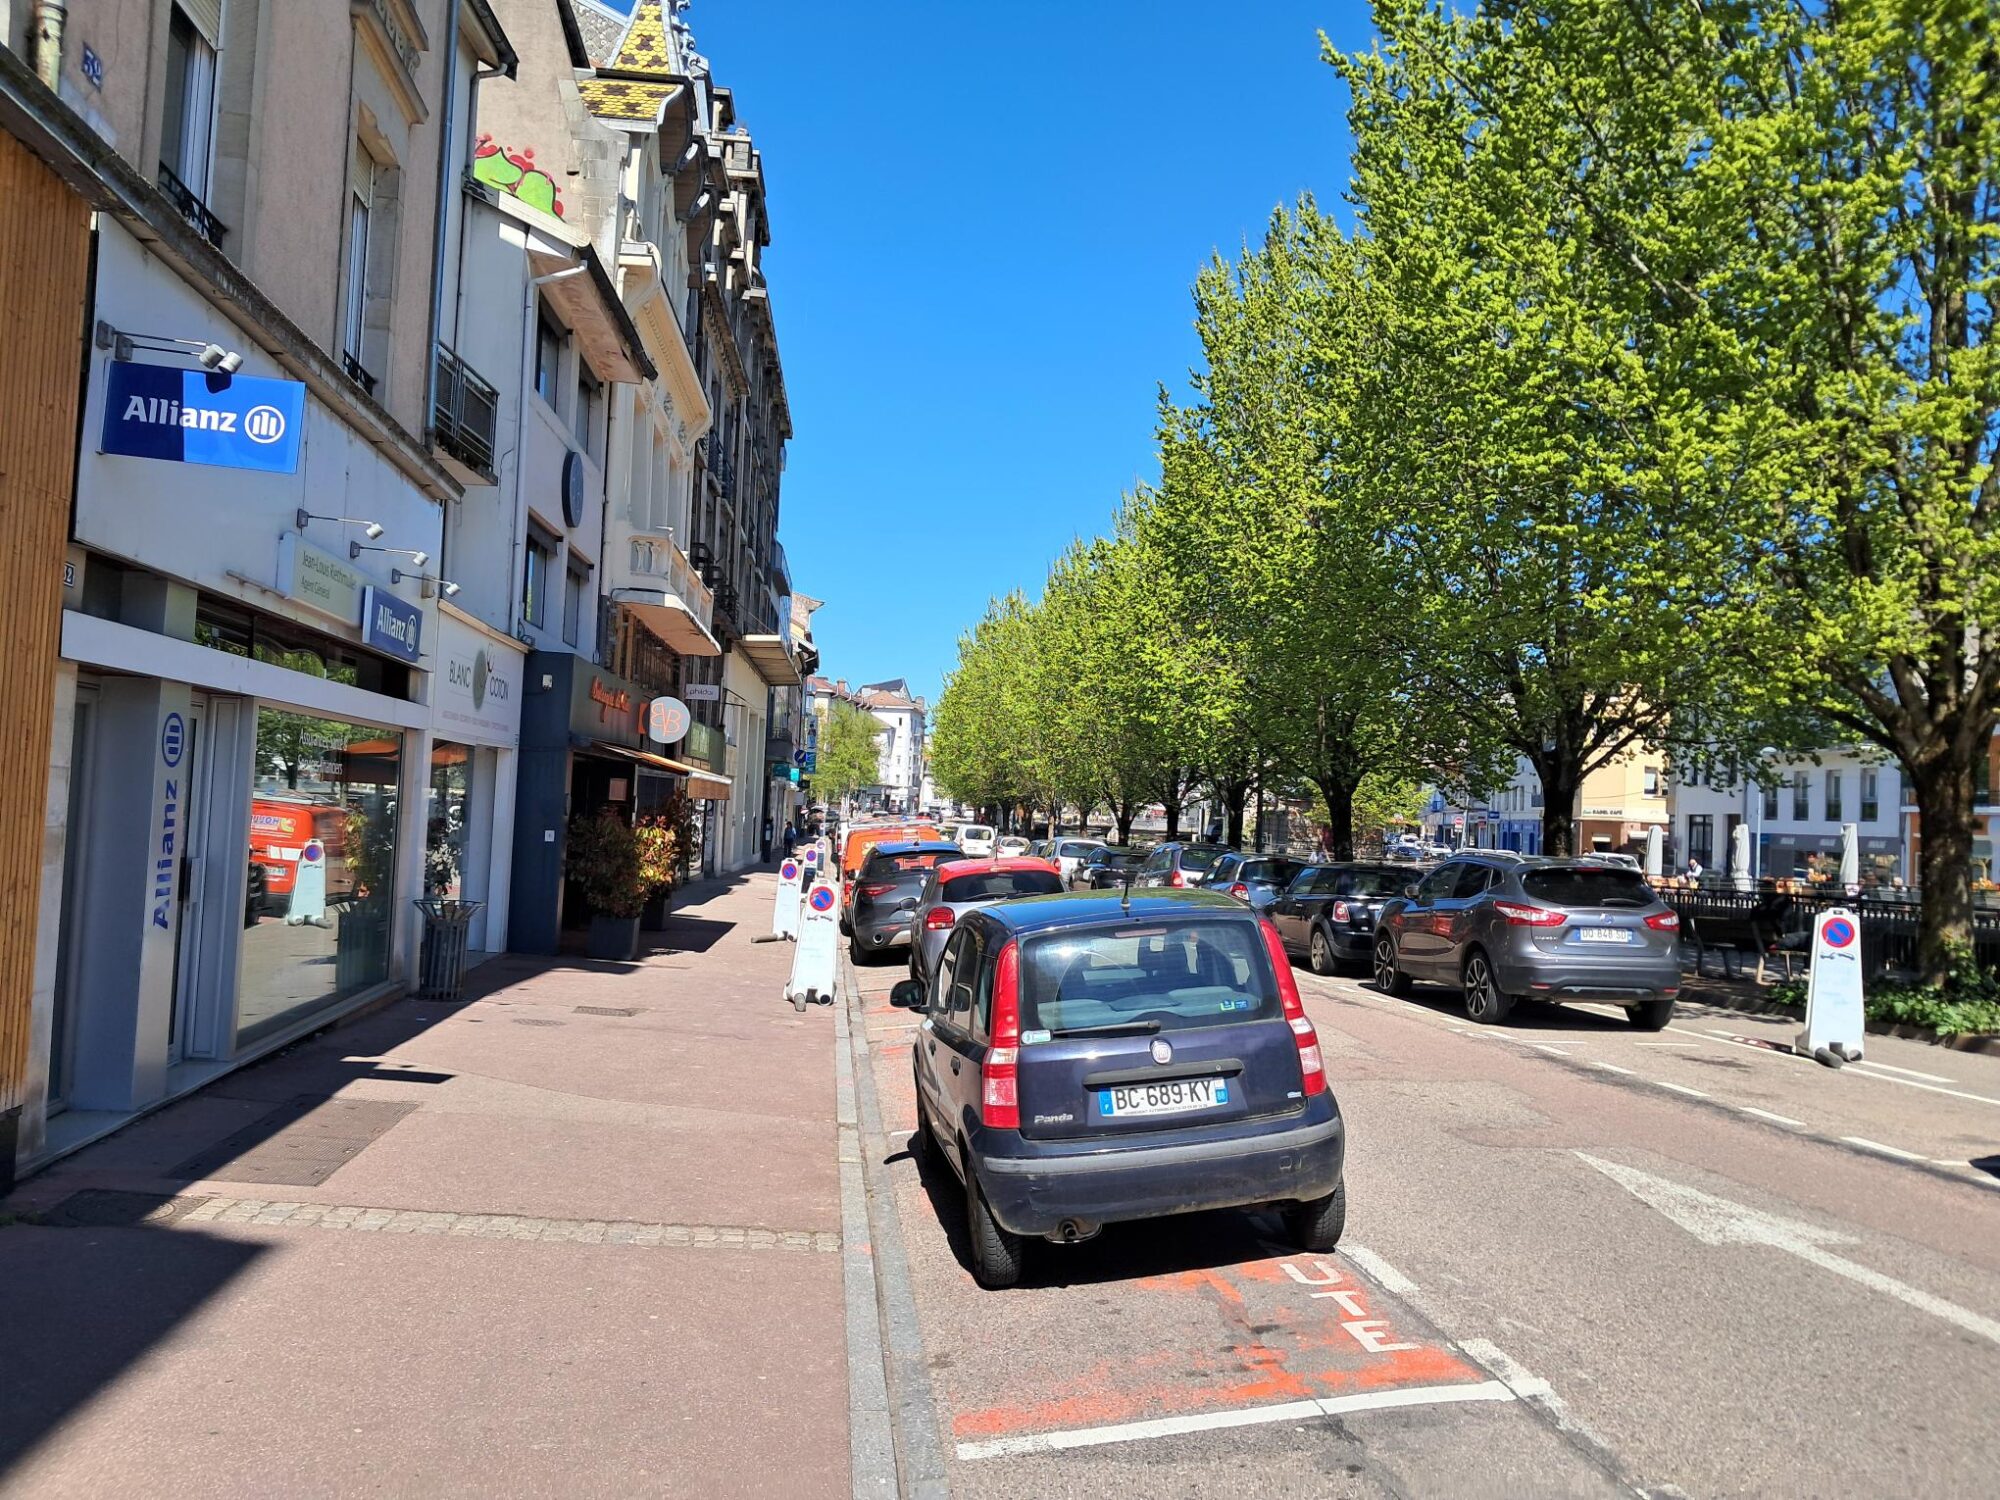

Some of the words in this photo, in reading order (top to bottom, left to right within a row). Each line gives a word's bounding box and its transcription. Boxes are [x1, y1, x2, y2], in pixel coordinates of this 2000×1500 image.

[123, 395, 237, 433] Allianz
[376, 604, 406, 642] Allianz
[449, 659, 471, 688] BLANC
[489, 675, 509, 700] COTON
[152, 779, 178, 930] Allianz
[1115, 1080, 1212, 1110] BC-689-KY
[1034, 1113, 1074, 1124] Panda
